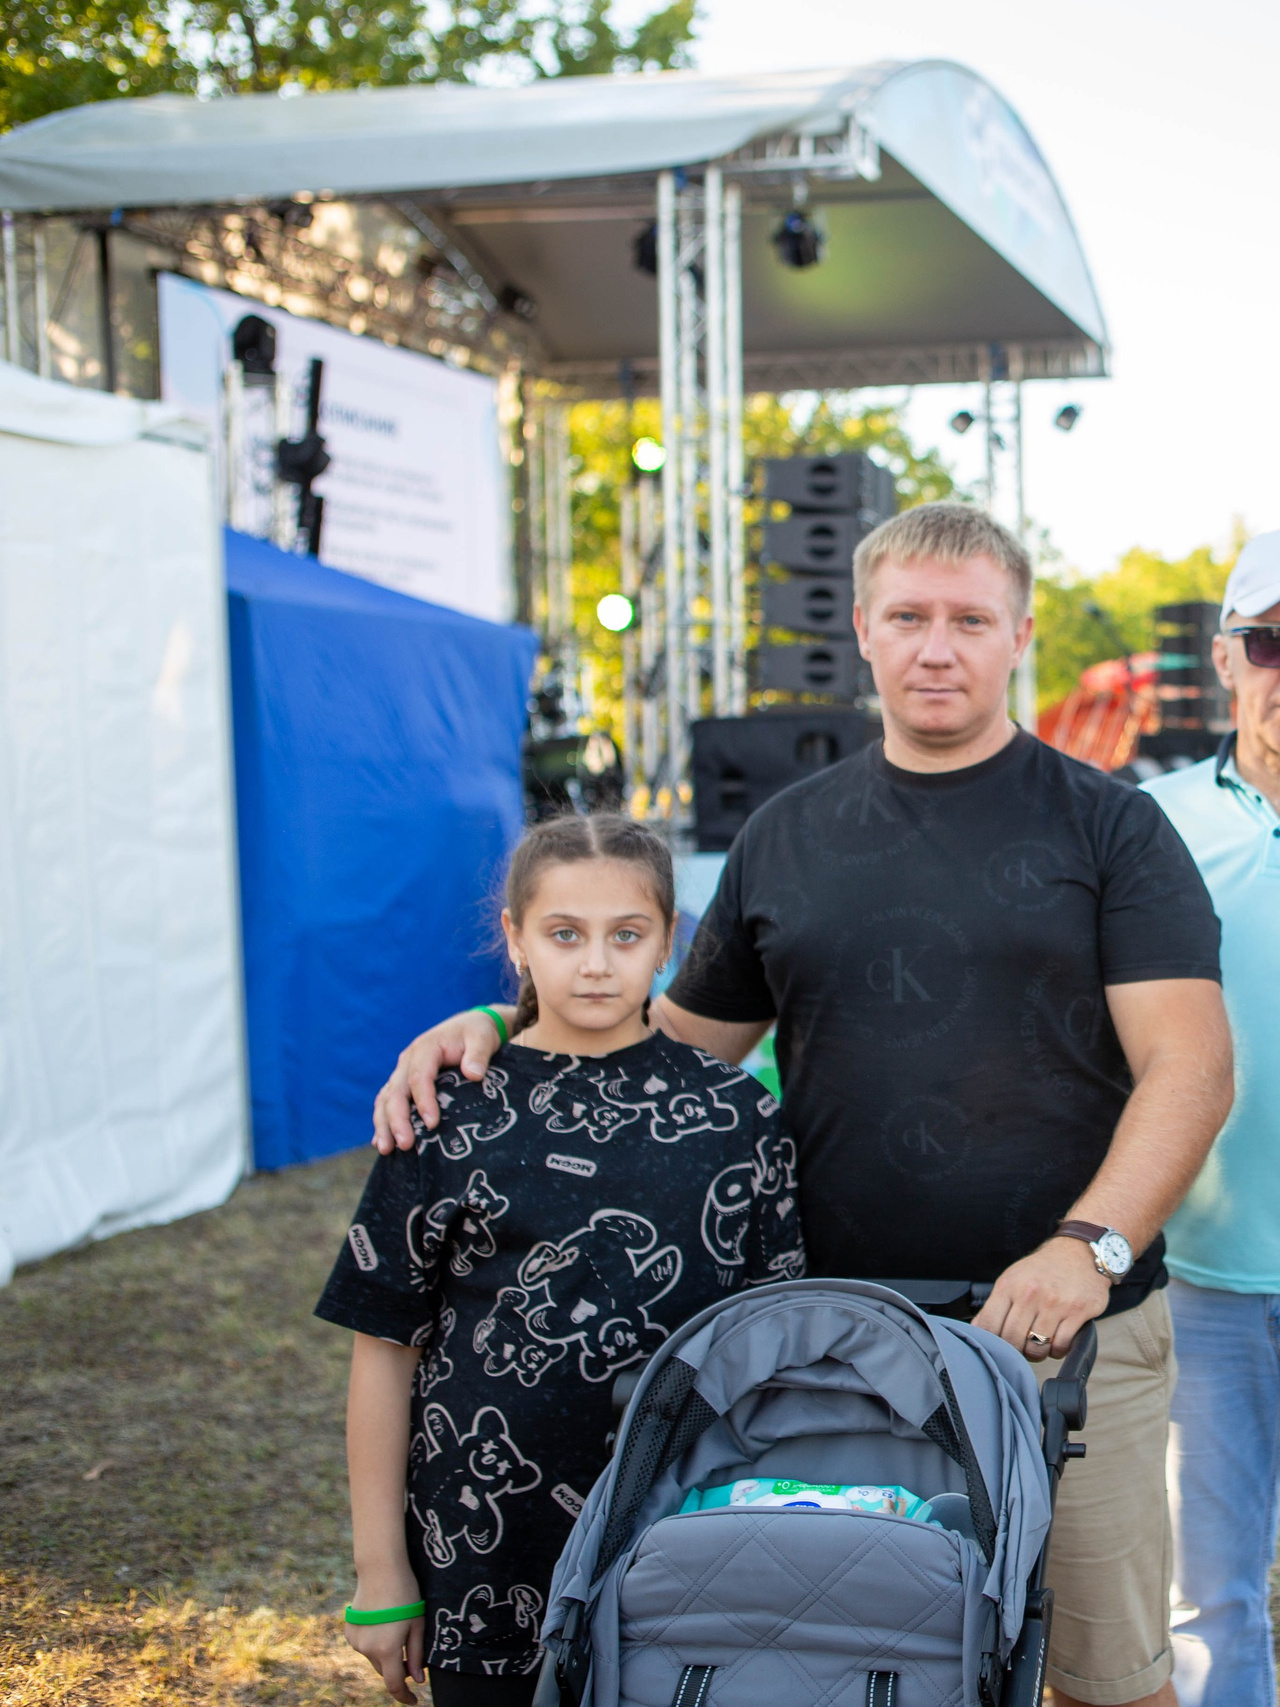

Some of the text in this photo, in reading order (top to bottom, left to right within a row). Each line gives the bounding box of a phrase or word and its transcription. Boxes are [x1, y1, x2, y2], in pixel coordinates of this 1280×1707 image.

[861, 906, 908, 928] CALVIN
[909, 907, 945, 925] KLEIN
[1024, 958, 1061, 1006] JEANS
[883, 966, 979, 1050] CALVIN KLEIN JEANS
[550, 1157, 592, 1173] MGGM
[352, 1228, 373, 1267] MGGM
[555, 1488, 583, 1513] GGM
